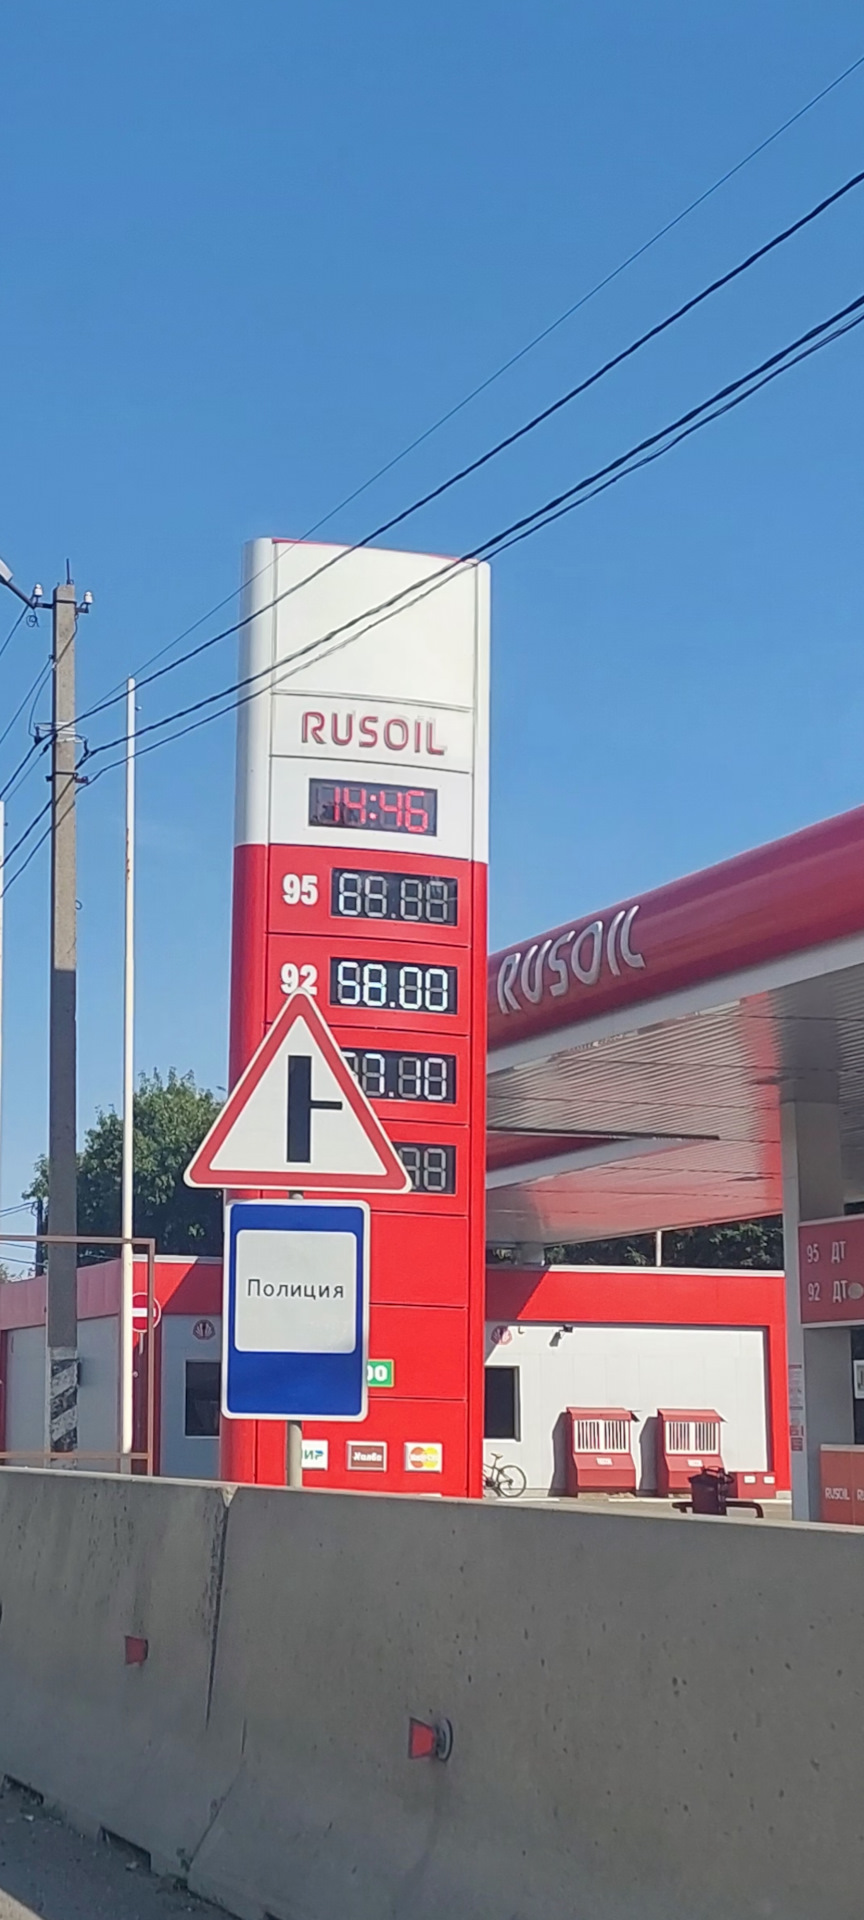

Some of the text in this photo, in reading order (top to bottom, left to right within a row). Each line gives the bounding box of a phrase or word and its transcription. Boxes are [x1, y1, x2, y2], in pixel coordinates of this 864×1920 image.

[301, 711, 447, 755] RUSOIL
[333, 786, 429, 833] 14:46
[282, 874, 318, 905] 95
[496, 904, 646, 1015] RUSOIL
[280, 962, 317, 996] 92
[807, 1240, 847, 1264] 95 ДТ
[247, 1278, 344, 1300] Полиция
[807, 1279, 848, 1304] 92 ДТ
[825, 1487, 850, 1500] RUSOIL
